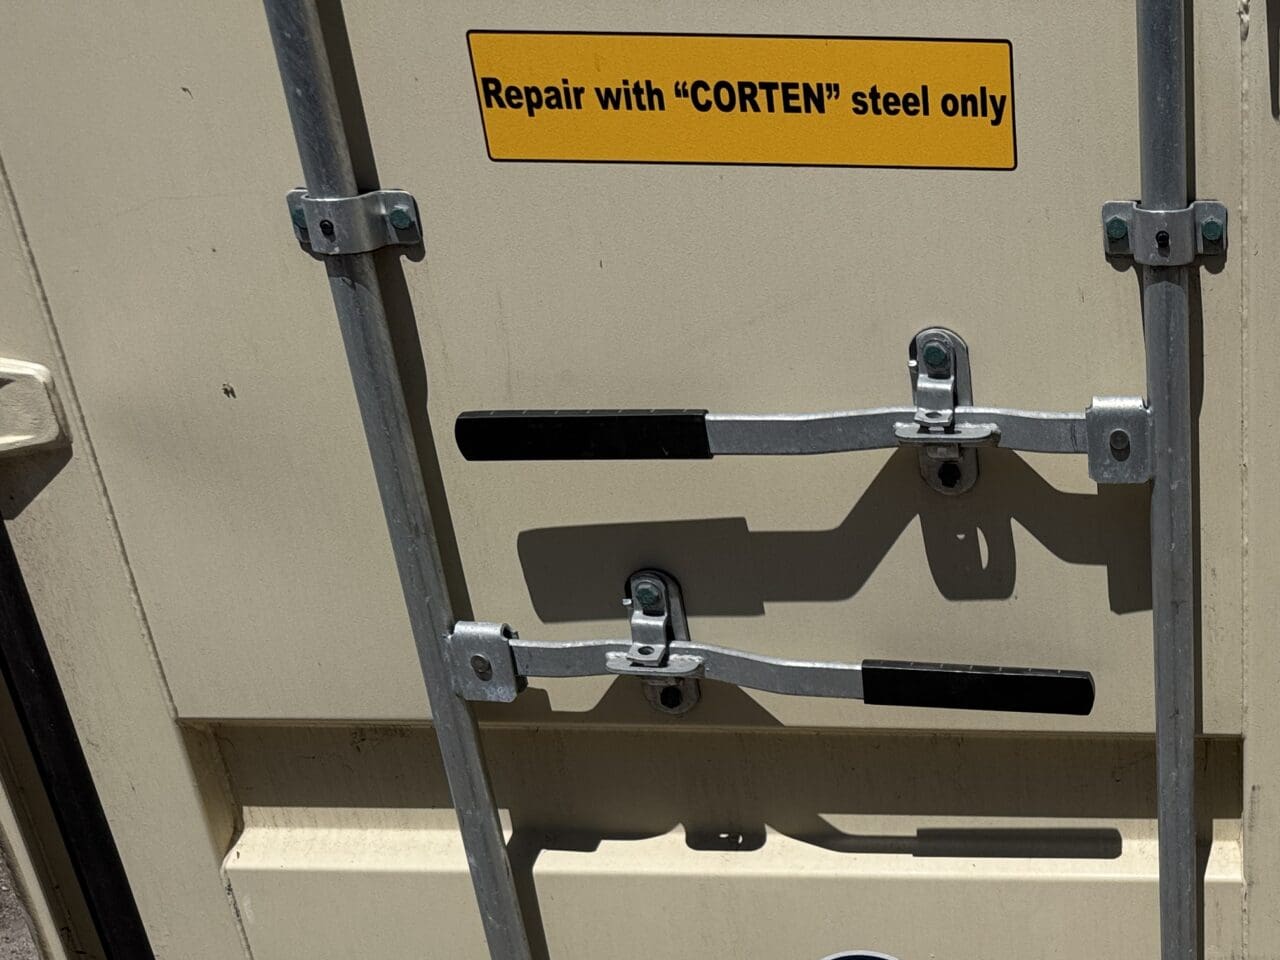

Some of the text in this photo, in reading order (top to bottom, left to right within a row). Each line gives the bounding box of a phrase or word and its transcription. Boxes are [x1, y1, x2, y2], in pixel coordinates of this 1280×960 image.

[481, 77, 1006, 126] Repair with “CORTEN” steel only
